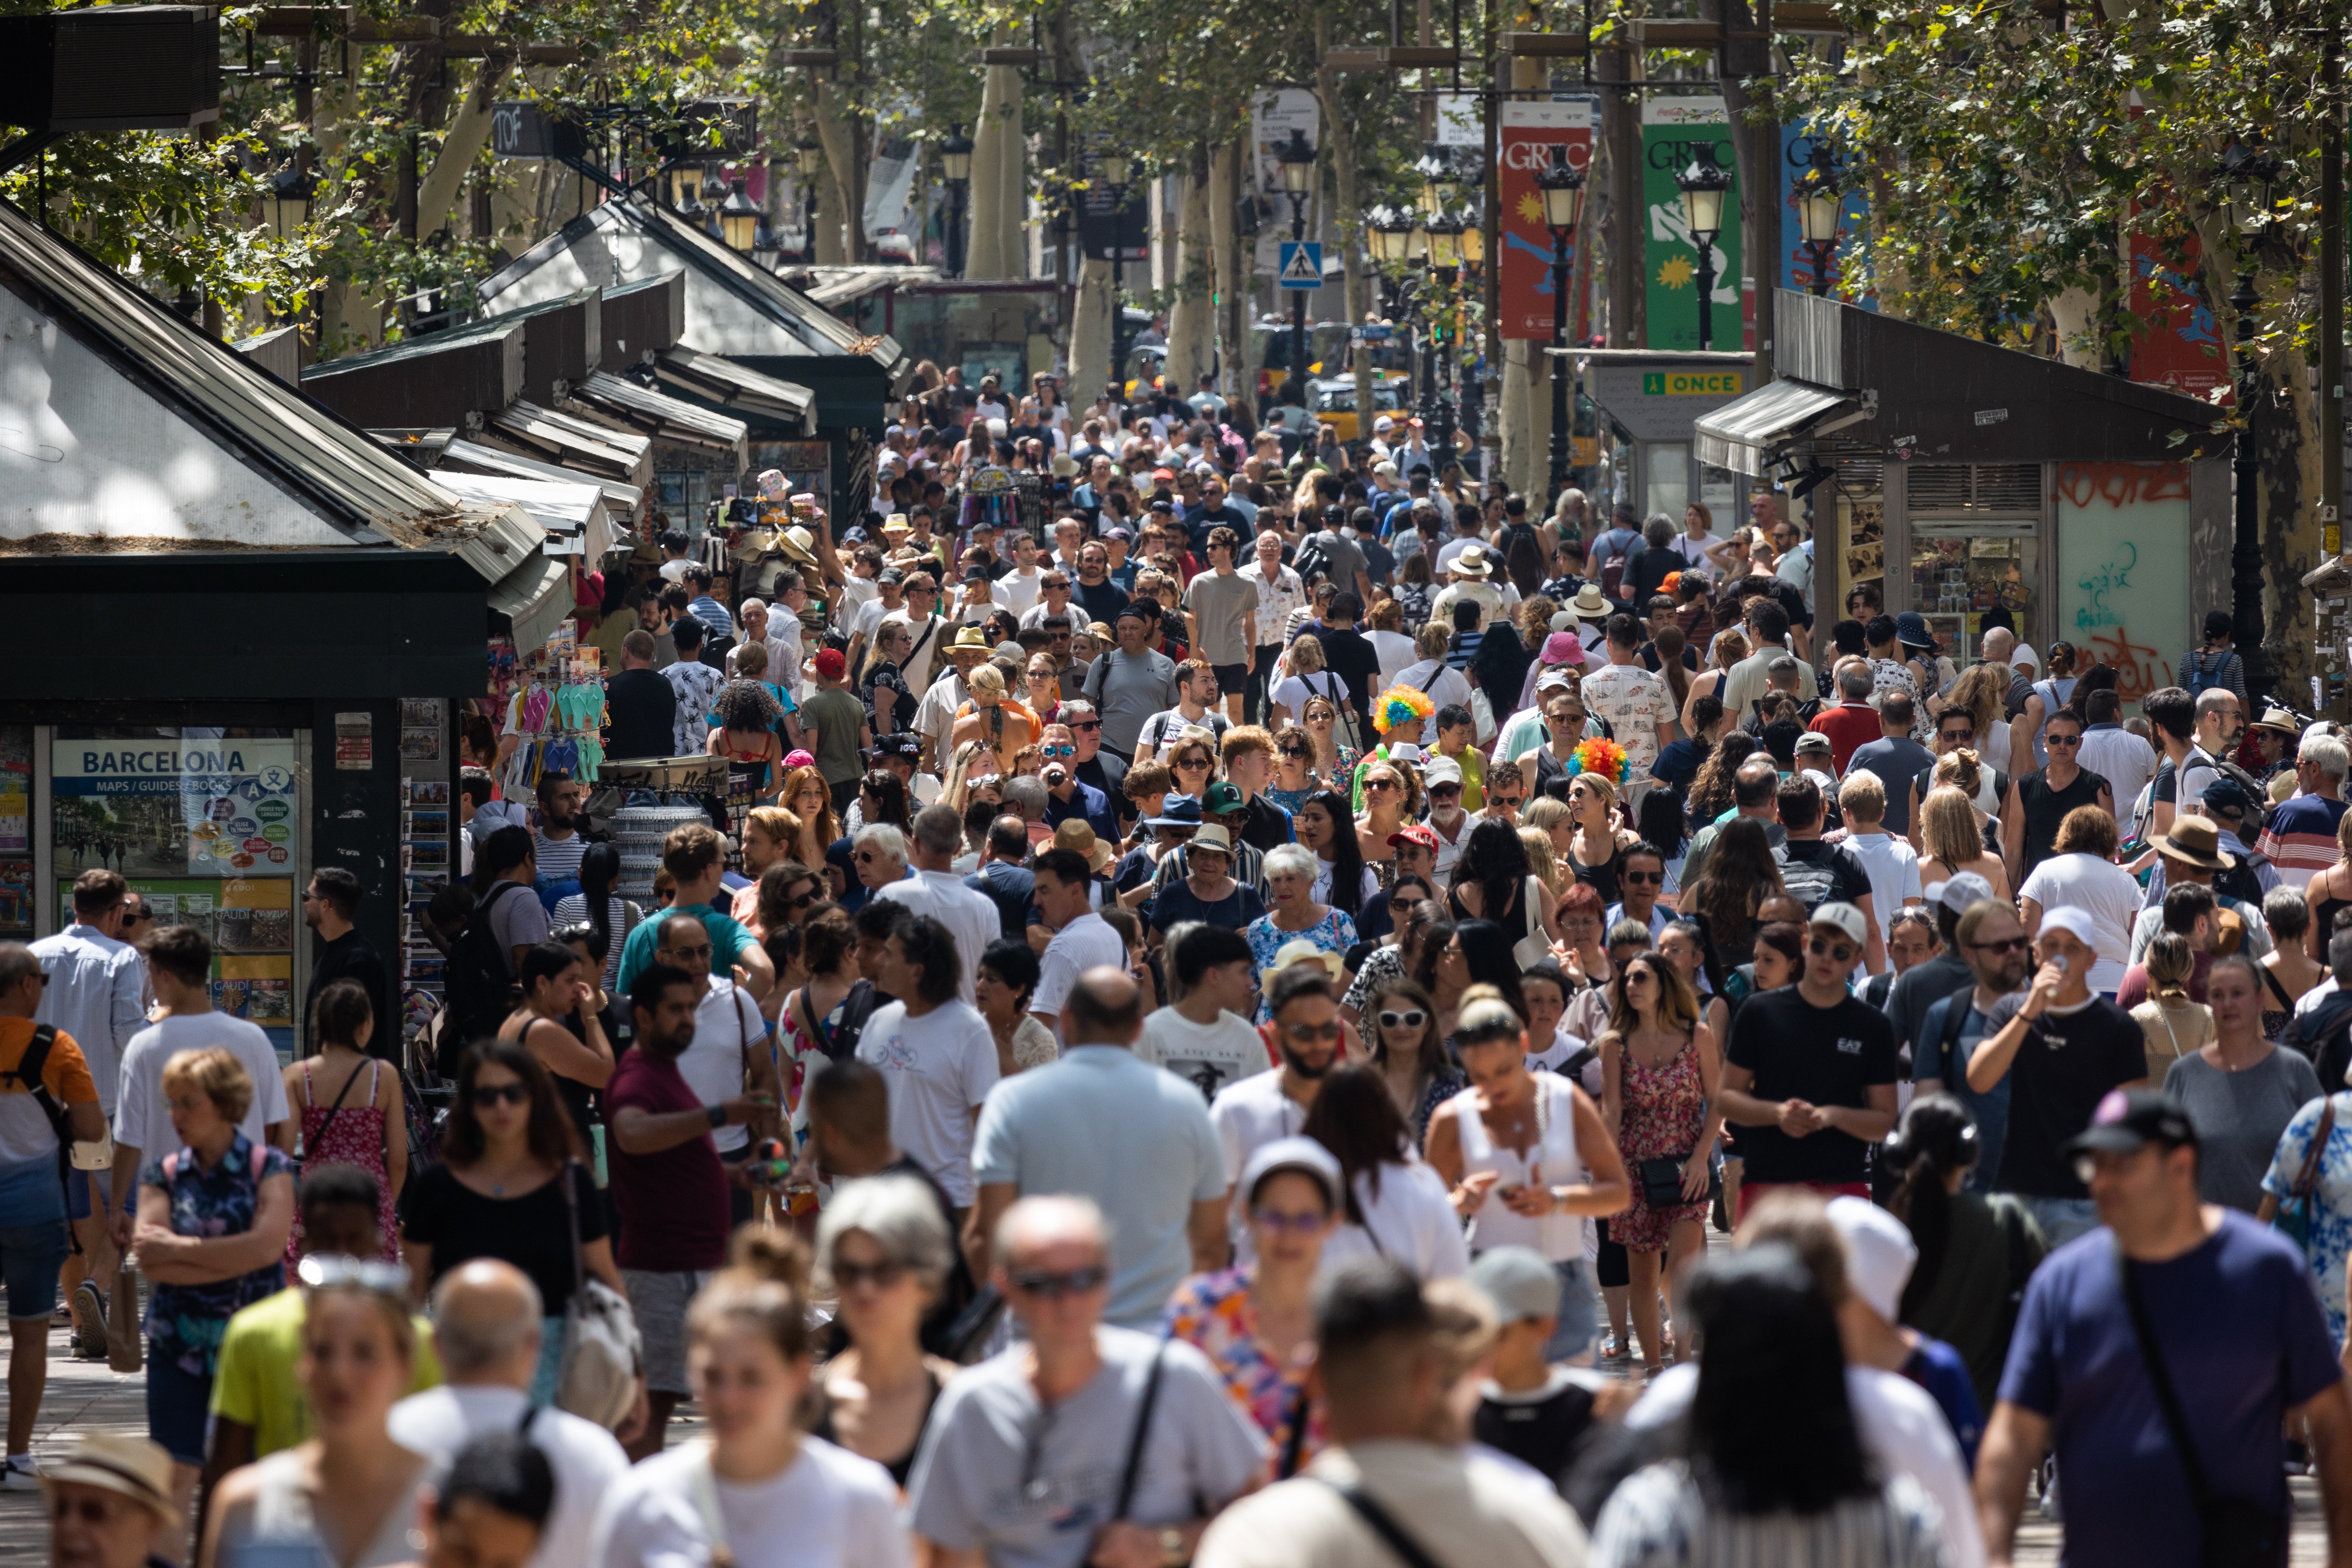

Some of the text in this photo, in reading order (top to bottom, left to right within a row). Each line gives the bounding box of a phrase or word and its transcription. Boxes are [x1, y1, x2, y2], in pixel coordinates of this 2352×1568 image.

[1505, 141, 1587, 170] GRC
[1648, 140, 1735, 170] GRC
[1674, 376, 1735, 392] ONCE
[84, 751, 245, 773] BARCELONA
[97, 781, 129, 791] MAPS
[132, 781, 136, 791] /
[139, 781, 180, 791] GUIDES
[192, 780, 231, 791] BOOKS
[248, 783, 259, 797] A
[215, 910, 249, 920] GAUDÍ
[214, 980, 248, 991] GAUDÍ
